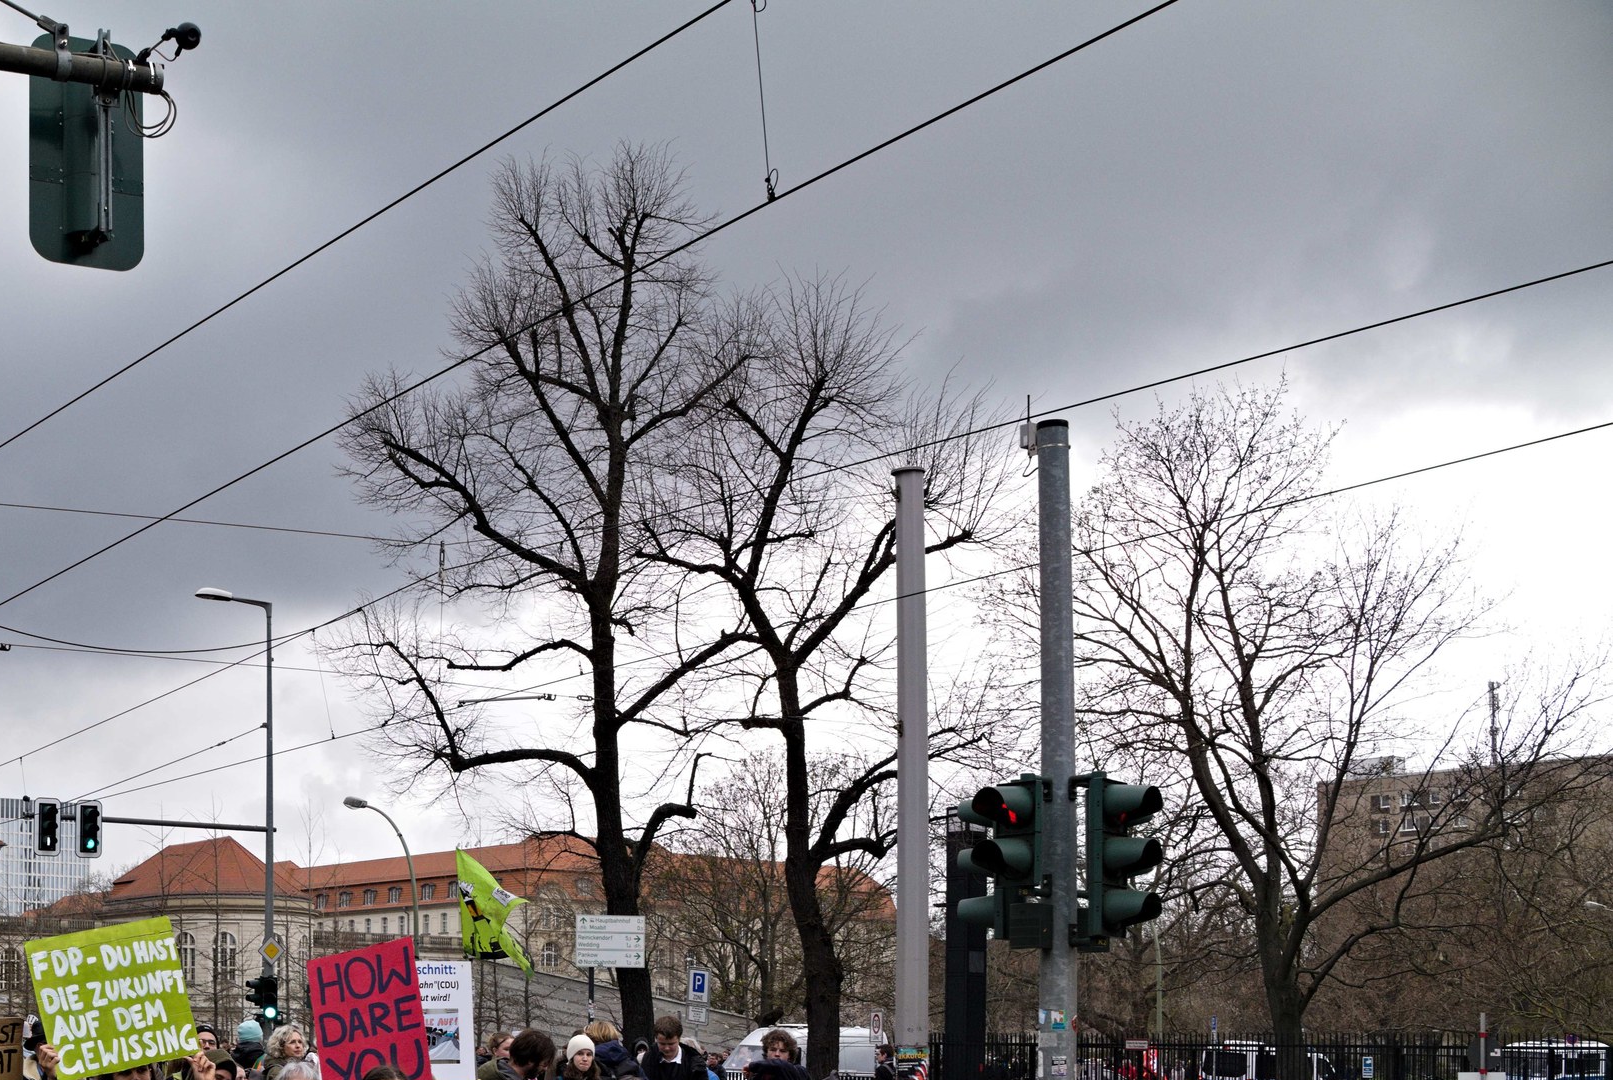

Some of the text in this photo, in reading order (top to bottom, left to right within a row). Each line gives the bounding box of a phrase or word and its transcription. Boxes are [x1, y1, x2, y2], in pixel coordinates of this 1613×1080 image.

[40, 969, 185, 1015] DIE ZUKUNFT
[316, 945, 412, 1006] HOW
[416, 964, 456, 975] schnitt:
[52, 998, 168, 1046] AUF DEM
[318, 994, 421, 1048] DARE
[430, 994, 451, 1002] wird!
[58, 1023, 199, 1076] GEWISSING
